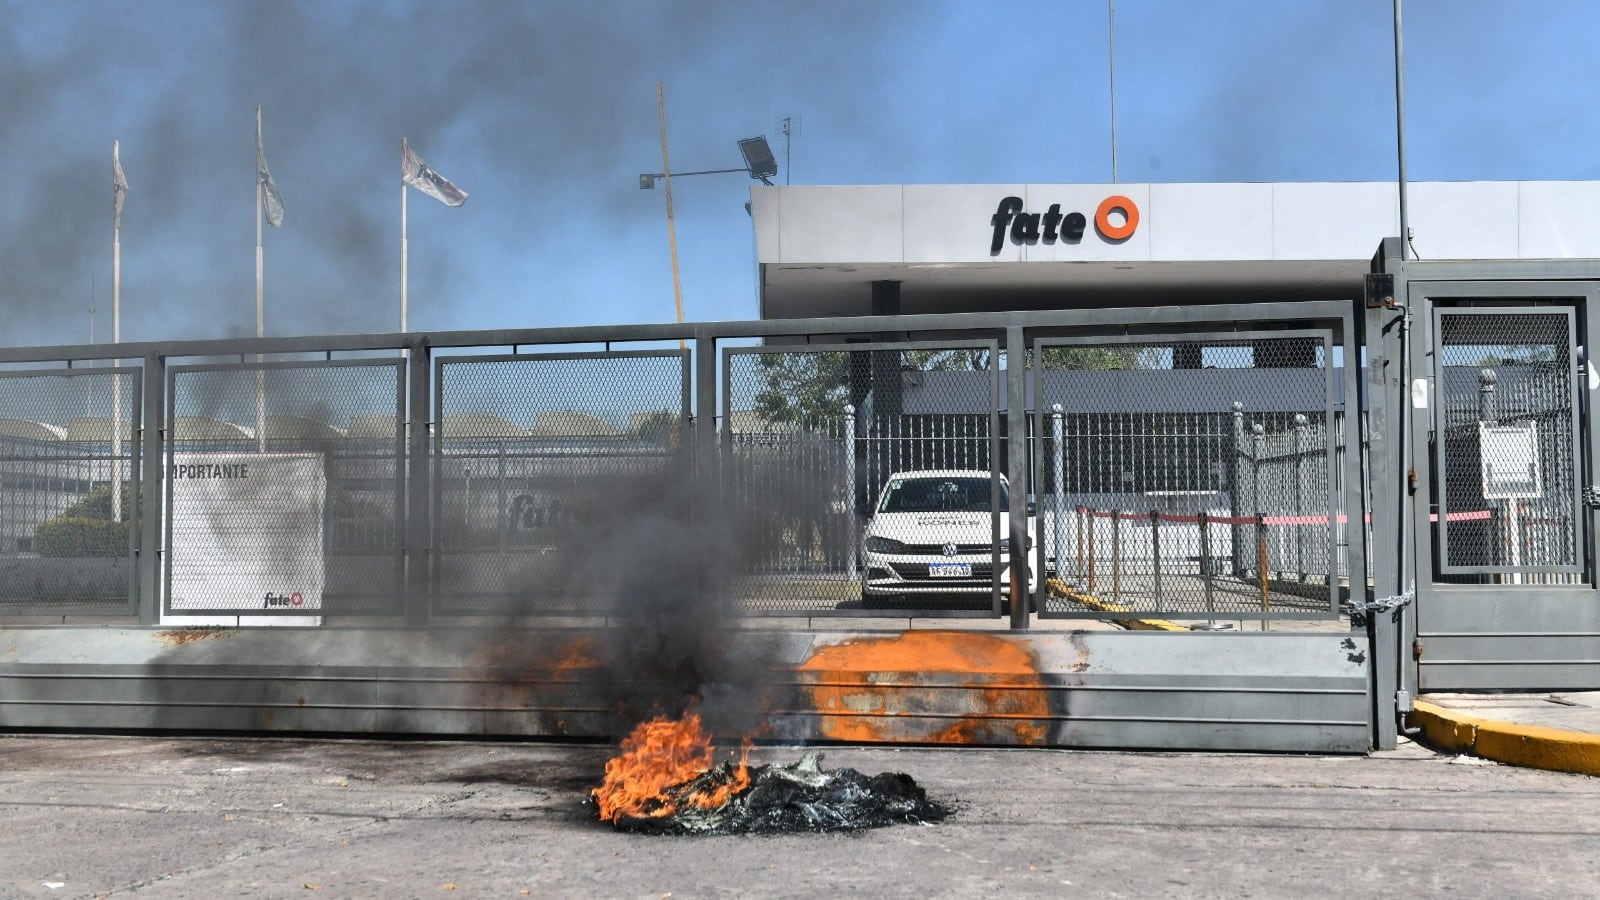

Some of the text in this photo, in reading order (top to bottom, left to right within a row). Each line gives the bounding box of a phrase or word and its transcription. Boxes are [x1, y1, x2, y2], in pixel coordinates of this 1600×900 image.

[990, 196, 1087, 254] fate
[162, 464, 248, 479] PORTANTE
[508, 494, 570, 536] fat
[264, 592, 290, 608] fate
